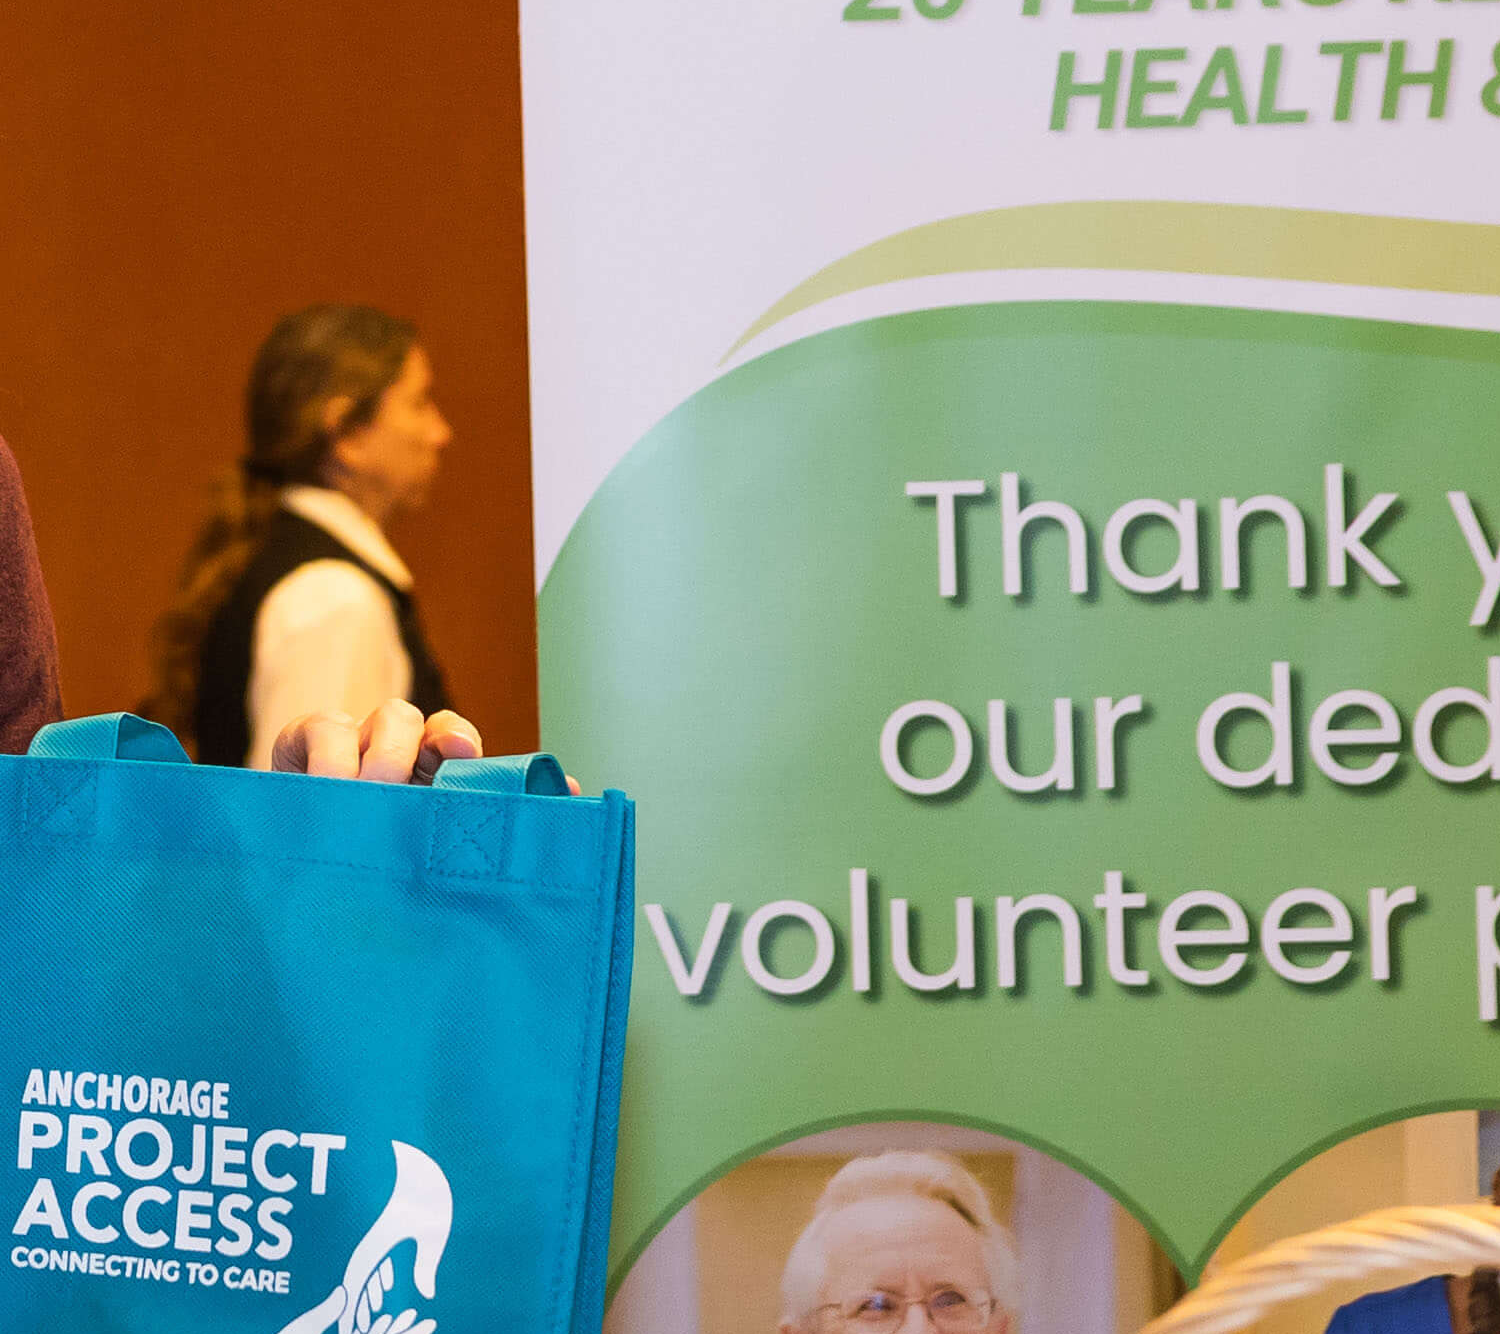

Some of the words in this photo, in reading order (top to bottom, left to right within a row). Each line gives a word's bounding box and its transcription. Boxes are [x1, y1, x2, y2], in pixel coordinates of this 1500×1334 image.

[1049, 37, 1456, 132] HEALTH
[905, 464, 1405, 603] Thank
[878, 690, 1148, 797] our
[643, 867, 1419, 998] volunteer
[21, 1069, 230, 1119] ANCHORAGE
[17, 1111, 346, 1195] PROJECT
[12, 1178, 295, 1261] ACCESS
[11, 1246, 180, 1283] CONNECTING
[187, 1261, 219, 1288] TO
[223, 1265, 292, 1294] CARE
